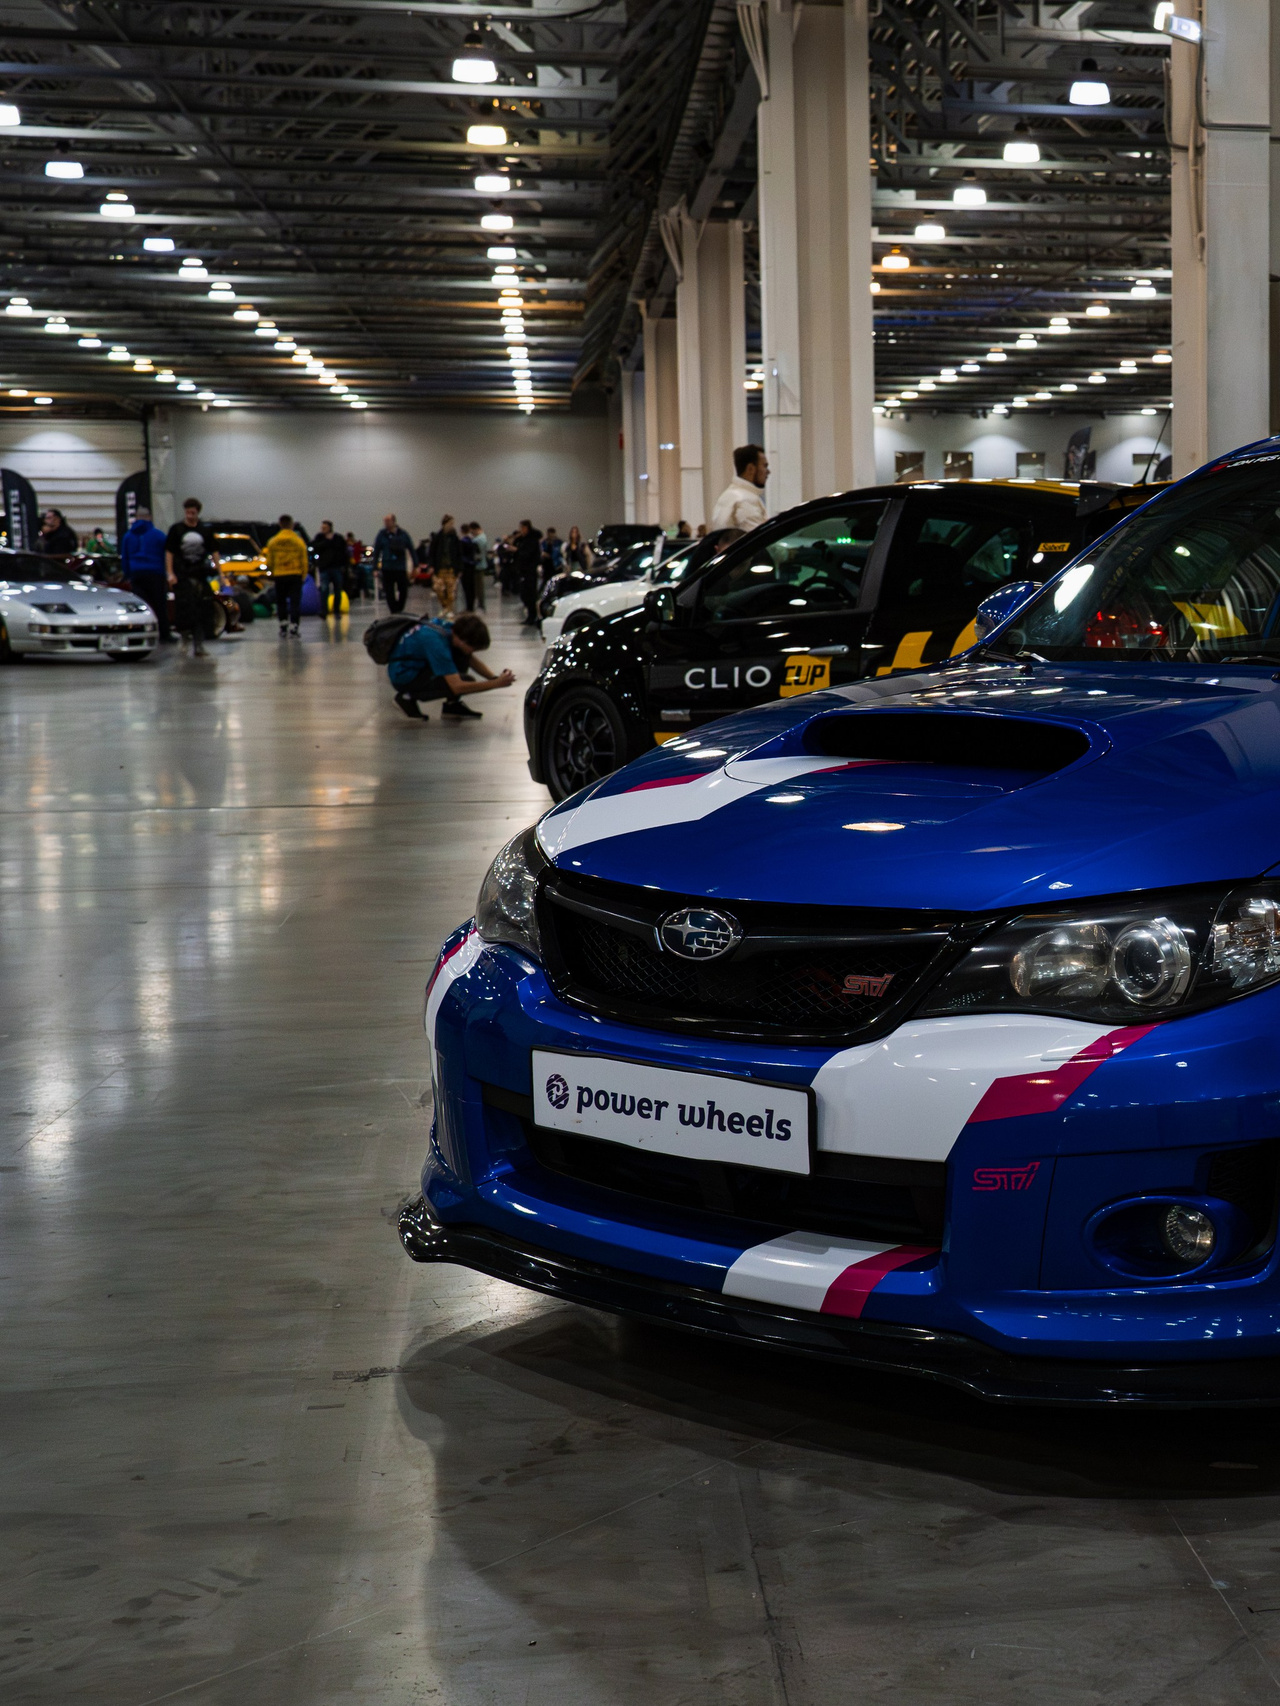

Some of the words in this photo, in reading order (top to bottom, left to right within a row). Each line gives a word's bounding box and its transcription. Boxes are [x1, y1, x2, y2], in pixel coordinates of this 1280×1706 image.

[684, 665, 772, 690] CLIO
[781, 664, 827, 687] CUP
[576, 1085, 669, 1121] power
[677, 1100, 792, 1141] wheels
